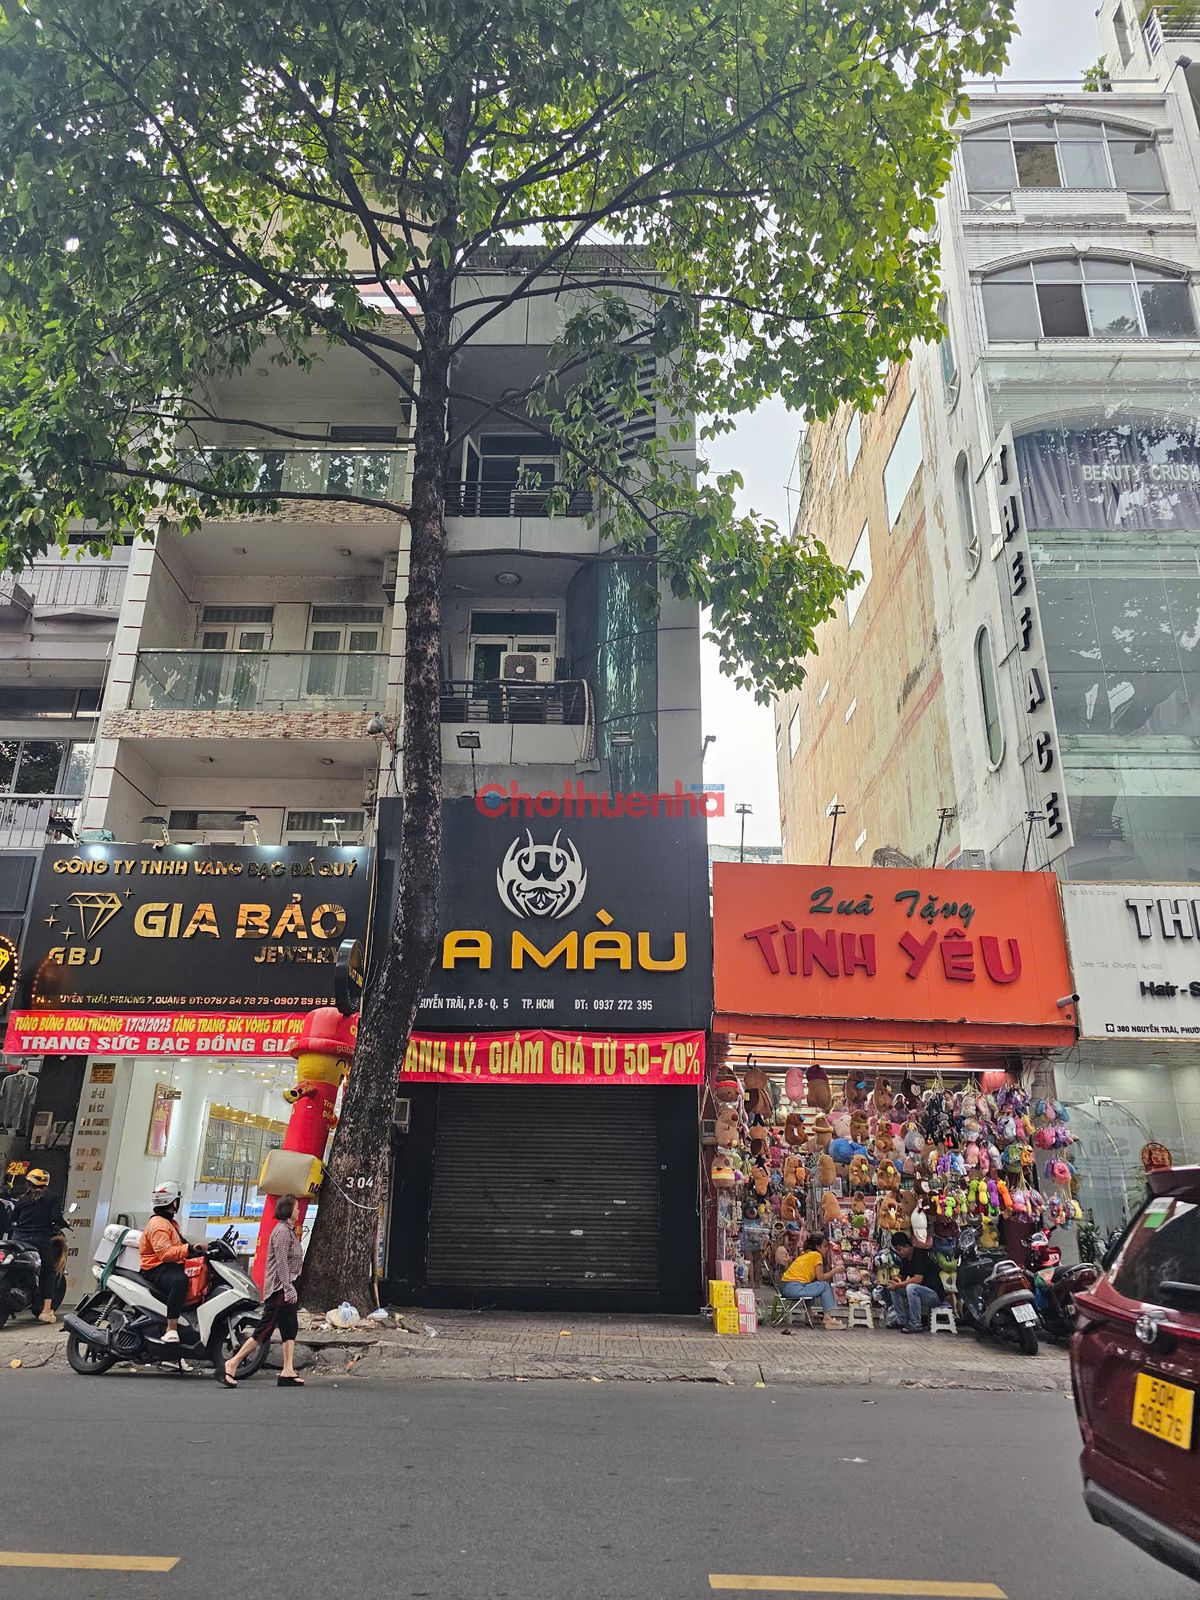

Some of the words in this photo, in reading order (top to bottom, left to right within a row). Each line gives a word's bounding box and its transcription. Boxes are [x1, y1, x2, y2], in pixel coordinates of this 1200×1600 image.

[1081, 464, 1141, 482] BEAUTY
[1150, 464, 1200, 481] CRUSH
[53, 855, 109, 874] CÔNG
[113, 860, 136, 875] TY
[141, 860, 189, 876] TNHH
[193, 856, 245, 877] VÀNG
[247, 861, 287, 881] BẠC
[290, 856, 317, 877] ĐÁ
[318, 858, 358, 877] QUÝ
[133, 902, 221, 940] GIA
[235, 893, 347, 940] BẢO
[895, 889, 976, 928] Tặng
[442, 930, 494, 969] A
[511, 908, 688, 972] MÀU
[744, 919, 877, 977] TÌNH
[899, 927, 1022, 984] YÊU
[1139, 981, 1178, 997] Hair
[1188, 981, 1200, 997] S
[574, 999, 588, 1010] ĐT:
[593, 999, 613, 1010] 0937
[617, 1000, 633, 1010] 272
[636, 1000, 653, 1011] 395
[64, 1017, 89, 1031] KHAI
[125, 1017, 172, 1033] 17/3/2025
[196, 1018, 226, 1034] TRANG
[271, 1019, 288, 1034] TAY
[1180, 1026, 1200, 1035] PHƯỜ
[20, 1036, 91, 1051] TRANG
[97, 1034, 140, 1051] SỨC
[146, 1035, 190, 1055] BẠC
[195, 1033, 256, 1052] ĐỒNG
[262, 1036, 301, 1053] GIÁ
[404, 1040, 447, 1073] ANH
[453, 1036, 481, 1076] LÝ,
[489, 1032, 544, 1074] GIẢM
[551, 1036, 585, 1075] GIÁ
[592, 1036, 618, 1075] TỪ
[623, 1042, 700, 1075] 50-70%
